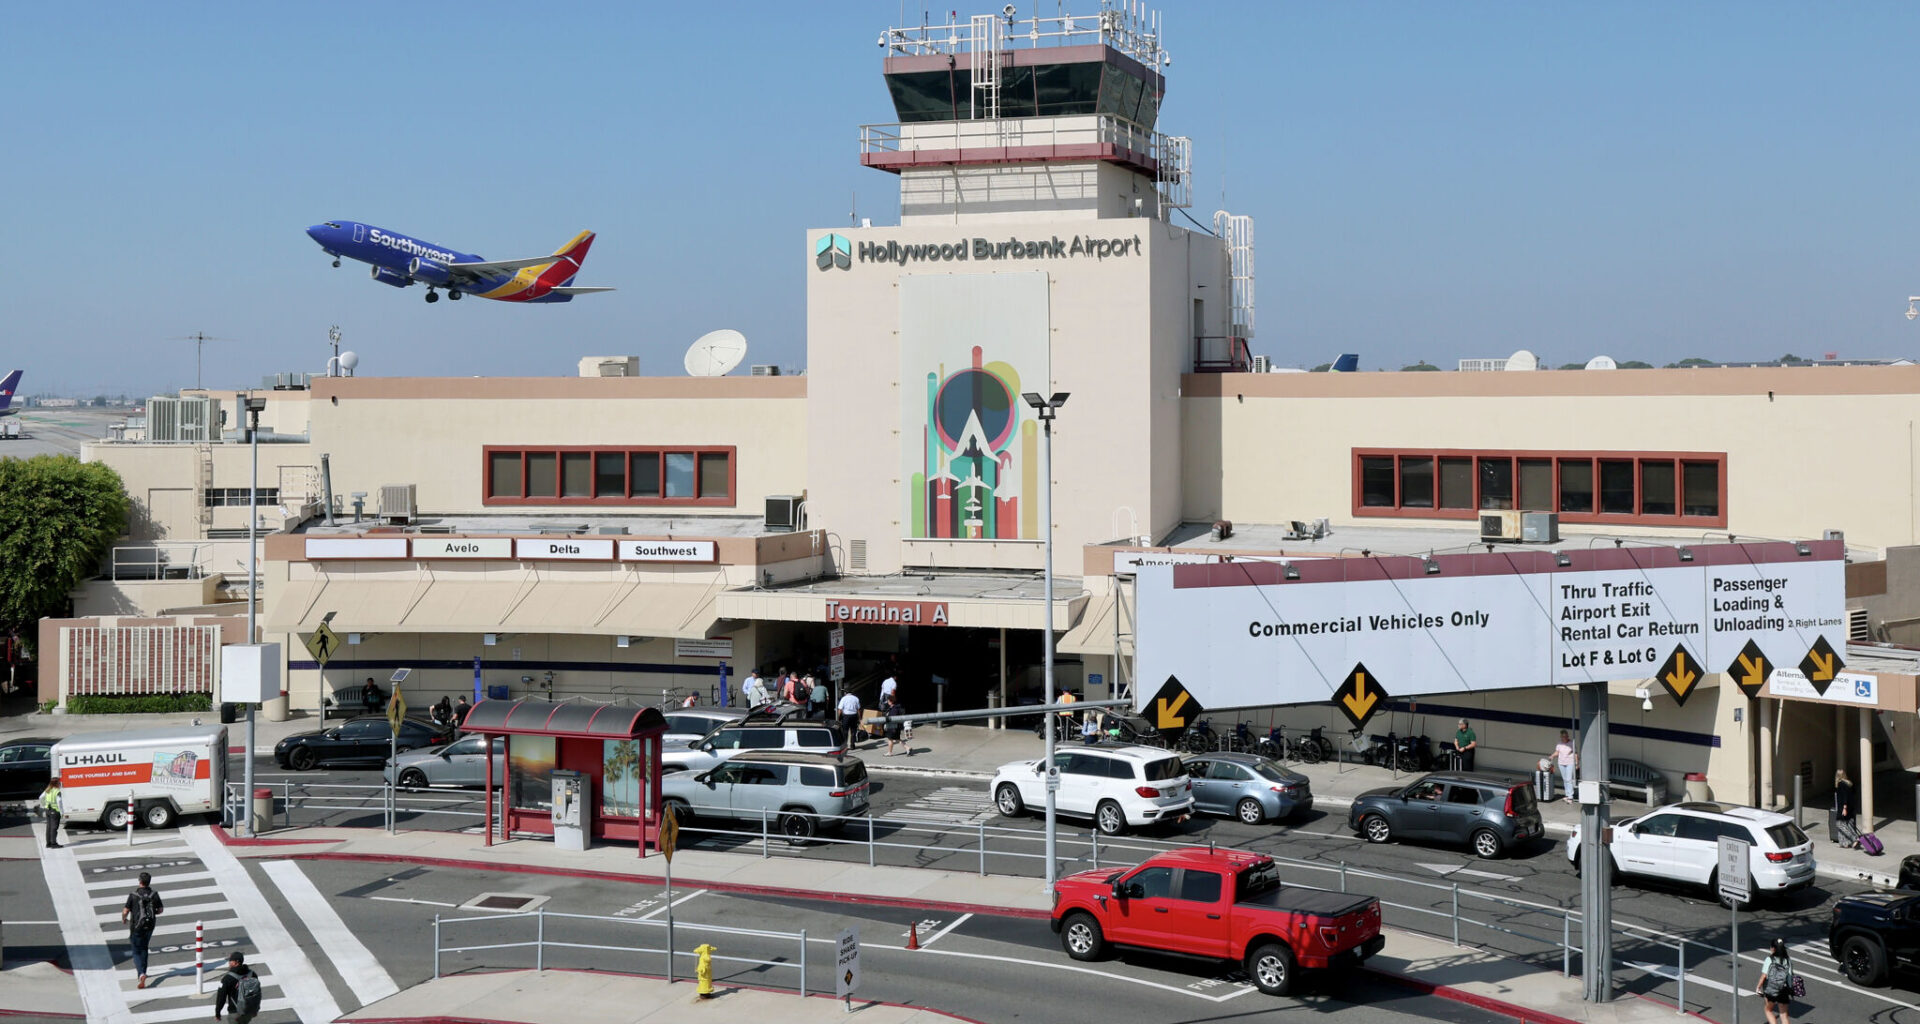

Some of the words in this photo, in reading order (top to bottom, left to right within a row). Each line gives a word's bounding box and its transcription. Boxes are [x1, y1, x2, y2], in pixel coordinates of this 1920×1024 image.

[370, 229, 456, 265] Southwest
[858, 239, 968, 266] Hollywood
[972, 236, 1066, 260] Burbank
[1070, 233, 1141, 261] Airport
[445, 543, 479, 553] Avelo
[549, 543, 580, 555] Delta
[635, 545, 697, 556] Southwest
[1561, 584, 1596, 600] Thru
[1602, 581, 1653, 598] Traffic
[1713, 575, 1788, 594] Passenger
[826, 600, 921, 623] Terminal
[933, 604, 948, 623] A
[1561, 605, 1616, 623] Airport
[1621, 603, 1650, 618] Exit
[1713, 595, 1769, 614] Loading
[1773, 594, 1784, 609] &
[1248, 615, 1362, 638] Commercial
[1369, 613, 1444, 631] Vehicles
[1451, 610, 1490, 628] Only
[1561, 626, 1613, 642] Rental
[1617, 623, 1642, 638] Car
[1648, 621, 1699, 637] Return
[1714, 615, 1784, 633] Unloading
[1788, 619, 1794, 628] 2
[1795, 619, 1817, 629] Right
[1819, 618, 1843, 627] Lanes
[1562, 652, 1587, 668] Lot
[1589, 651, 1598, 666] F
[1603, 650, 1614, 665] &
[1618, 648, 1643, 664] Lot
[1646, 647, 1656, 662] G
[1777, 670, 1807, 679] Alterna
[65, 753, 126, 765] U-HAUL
